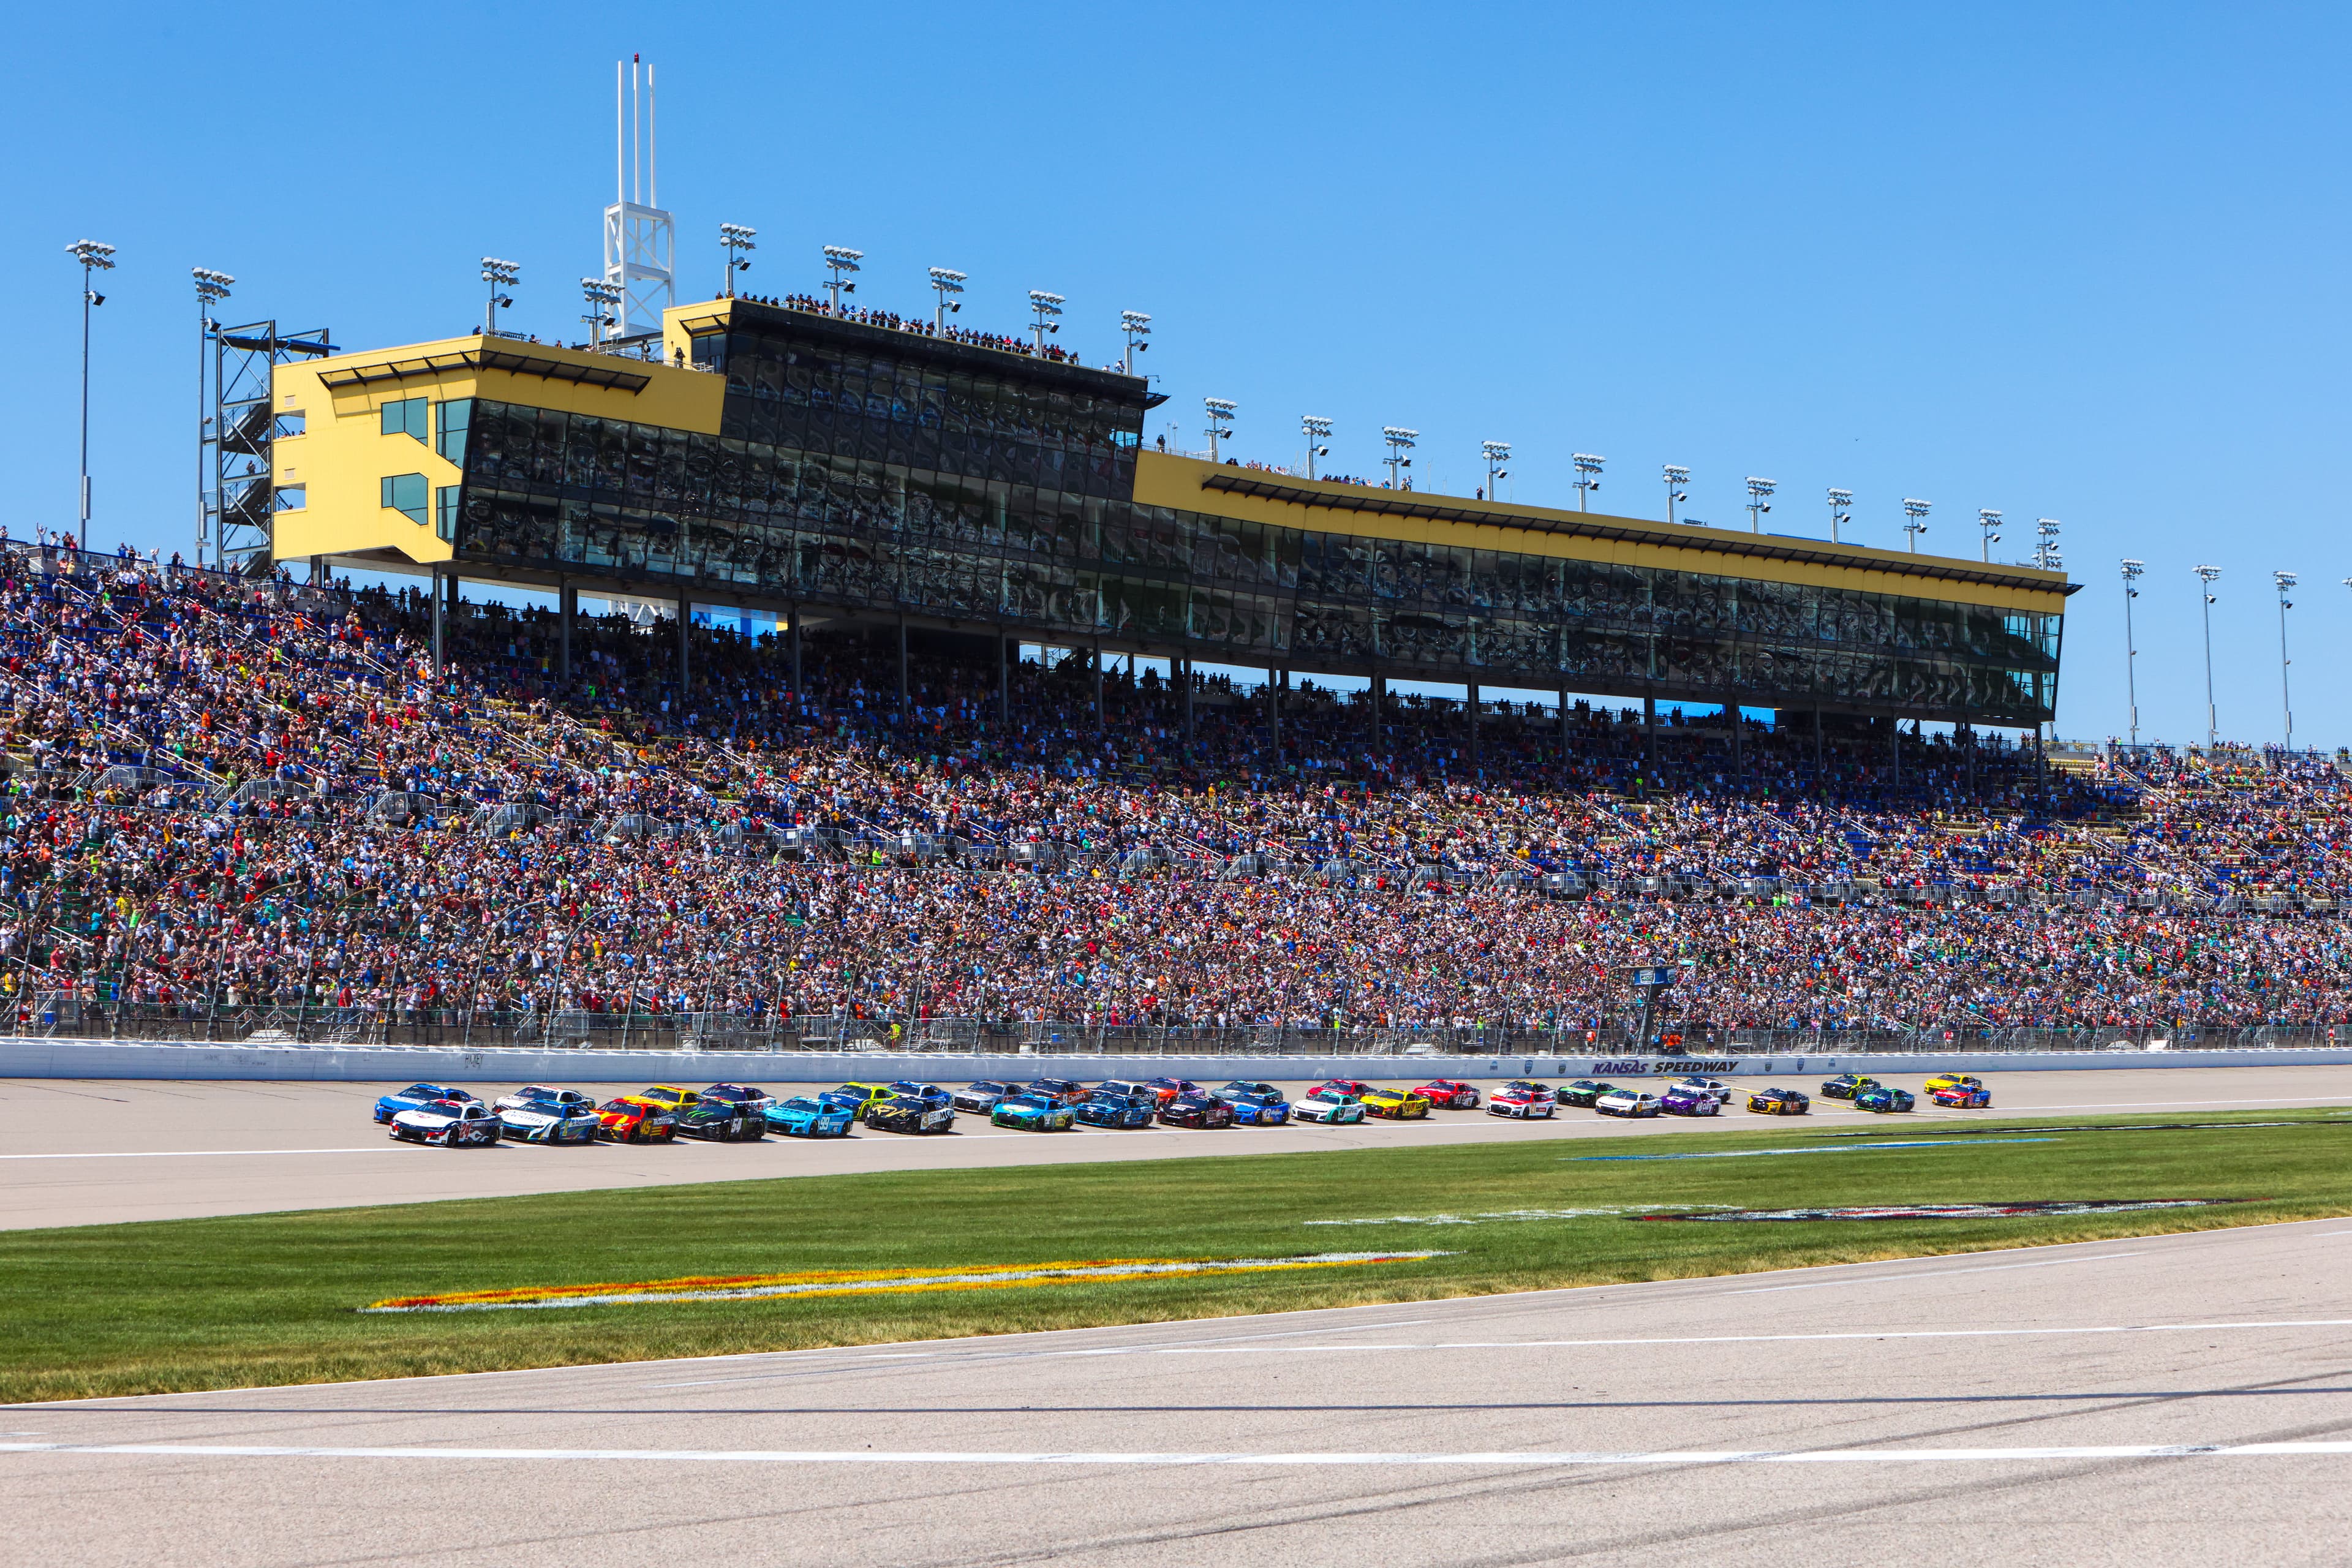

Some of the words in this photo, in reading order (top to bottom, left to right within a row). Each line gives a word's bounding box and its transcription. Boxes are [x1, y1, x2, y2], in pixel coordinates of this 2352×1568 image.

[1592, 1060, 1648, 1074] KANSAS
[1653, 1061, 1740, 1073] SPEEDWAY
[1263, 1108, 1271, 1119] 43
[1703, 1102, 1713, 1112] ally
[922, 1112, 929, 1127] 3
[1125, 1110, 1132, 1122] 2
[459, 1121, 472, 1139] 24
[562, 1120, 570, 1136] 1
[640, 1120, 652, 1134] 45
[731, 1118, 742, 1133] 54
[820, 1117, 830, 1130] 99
